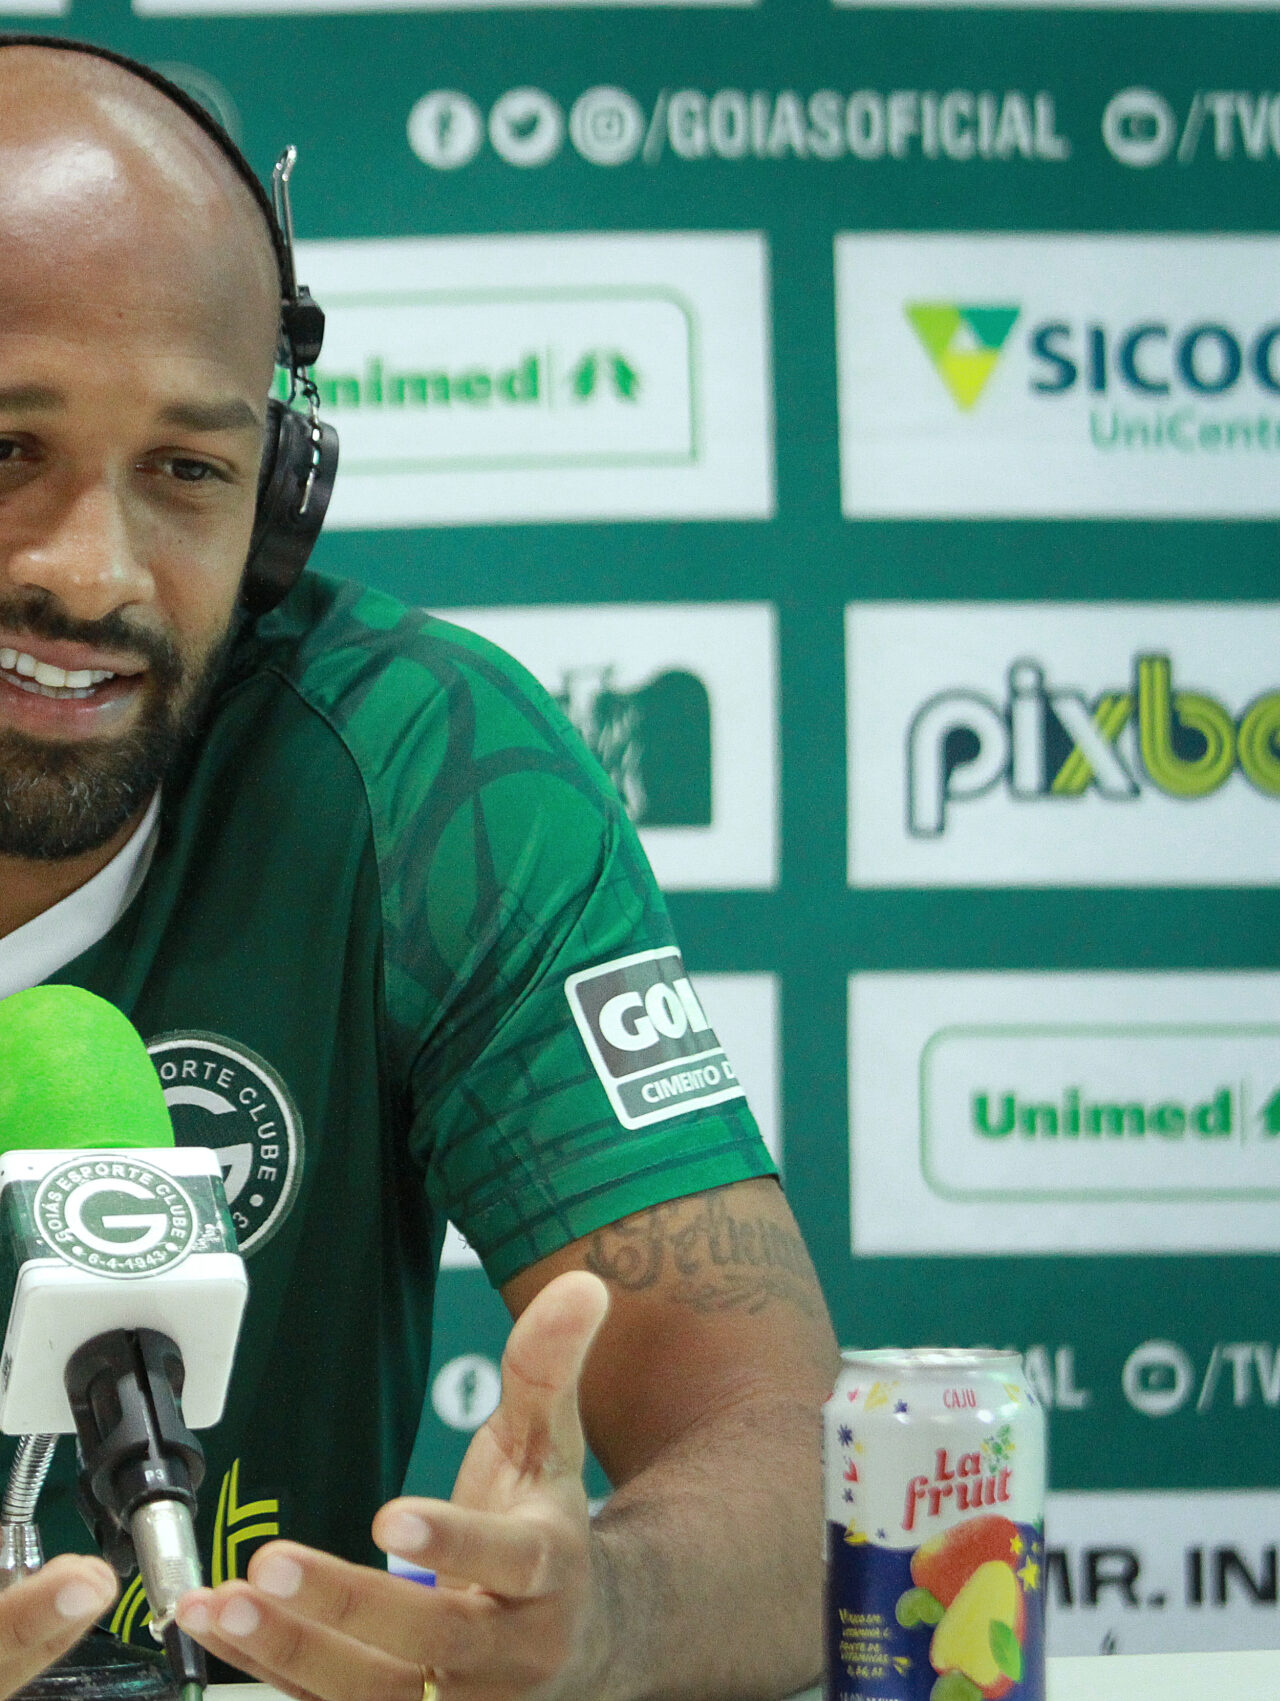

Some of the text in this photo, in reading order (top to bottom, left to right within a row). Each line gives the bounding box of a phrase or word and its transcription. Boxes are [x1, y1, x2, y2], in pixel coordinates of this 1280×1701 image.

[1090, 406, 1280, 451] UniCent
[239, 1087, 279, 1182] CLUBE
[973, 1087, 1232, 1140] Unimed
[42, 1162, 187, 1243] GOIÁS ESPORTE CLUBE
[943, 1388, 977, 1409] CAJU
[934, 1447, 982, 1482] La
[901, 1465, 1013, 1531] fruit
